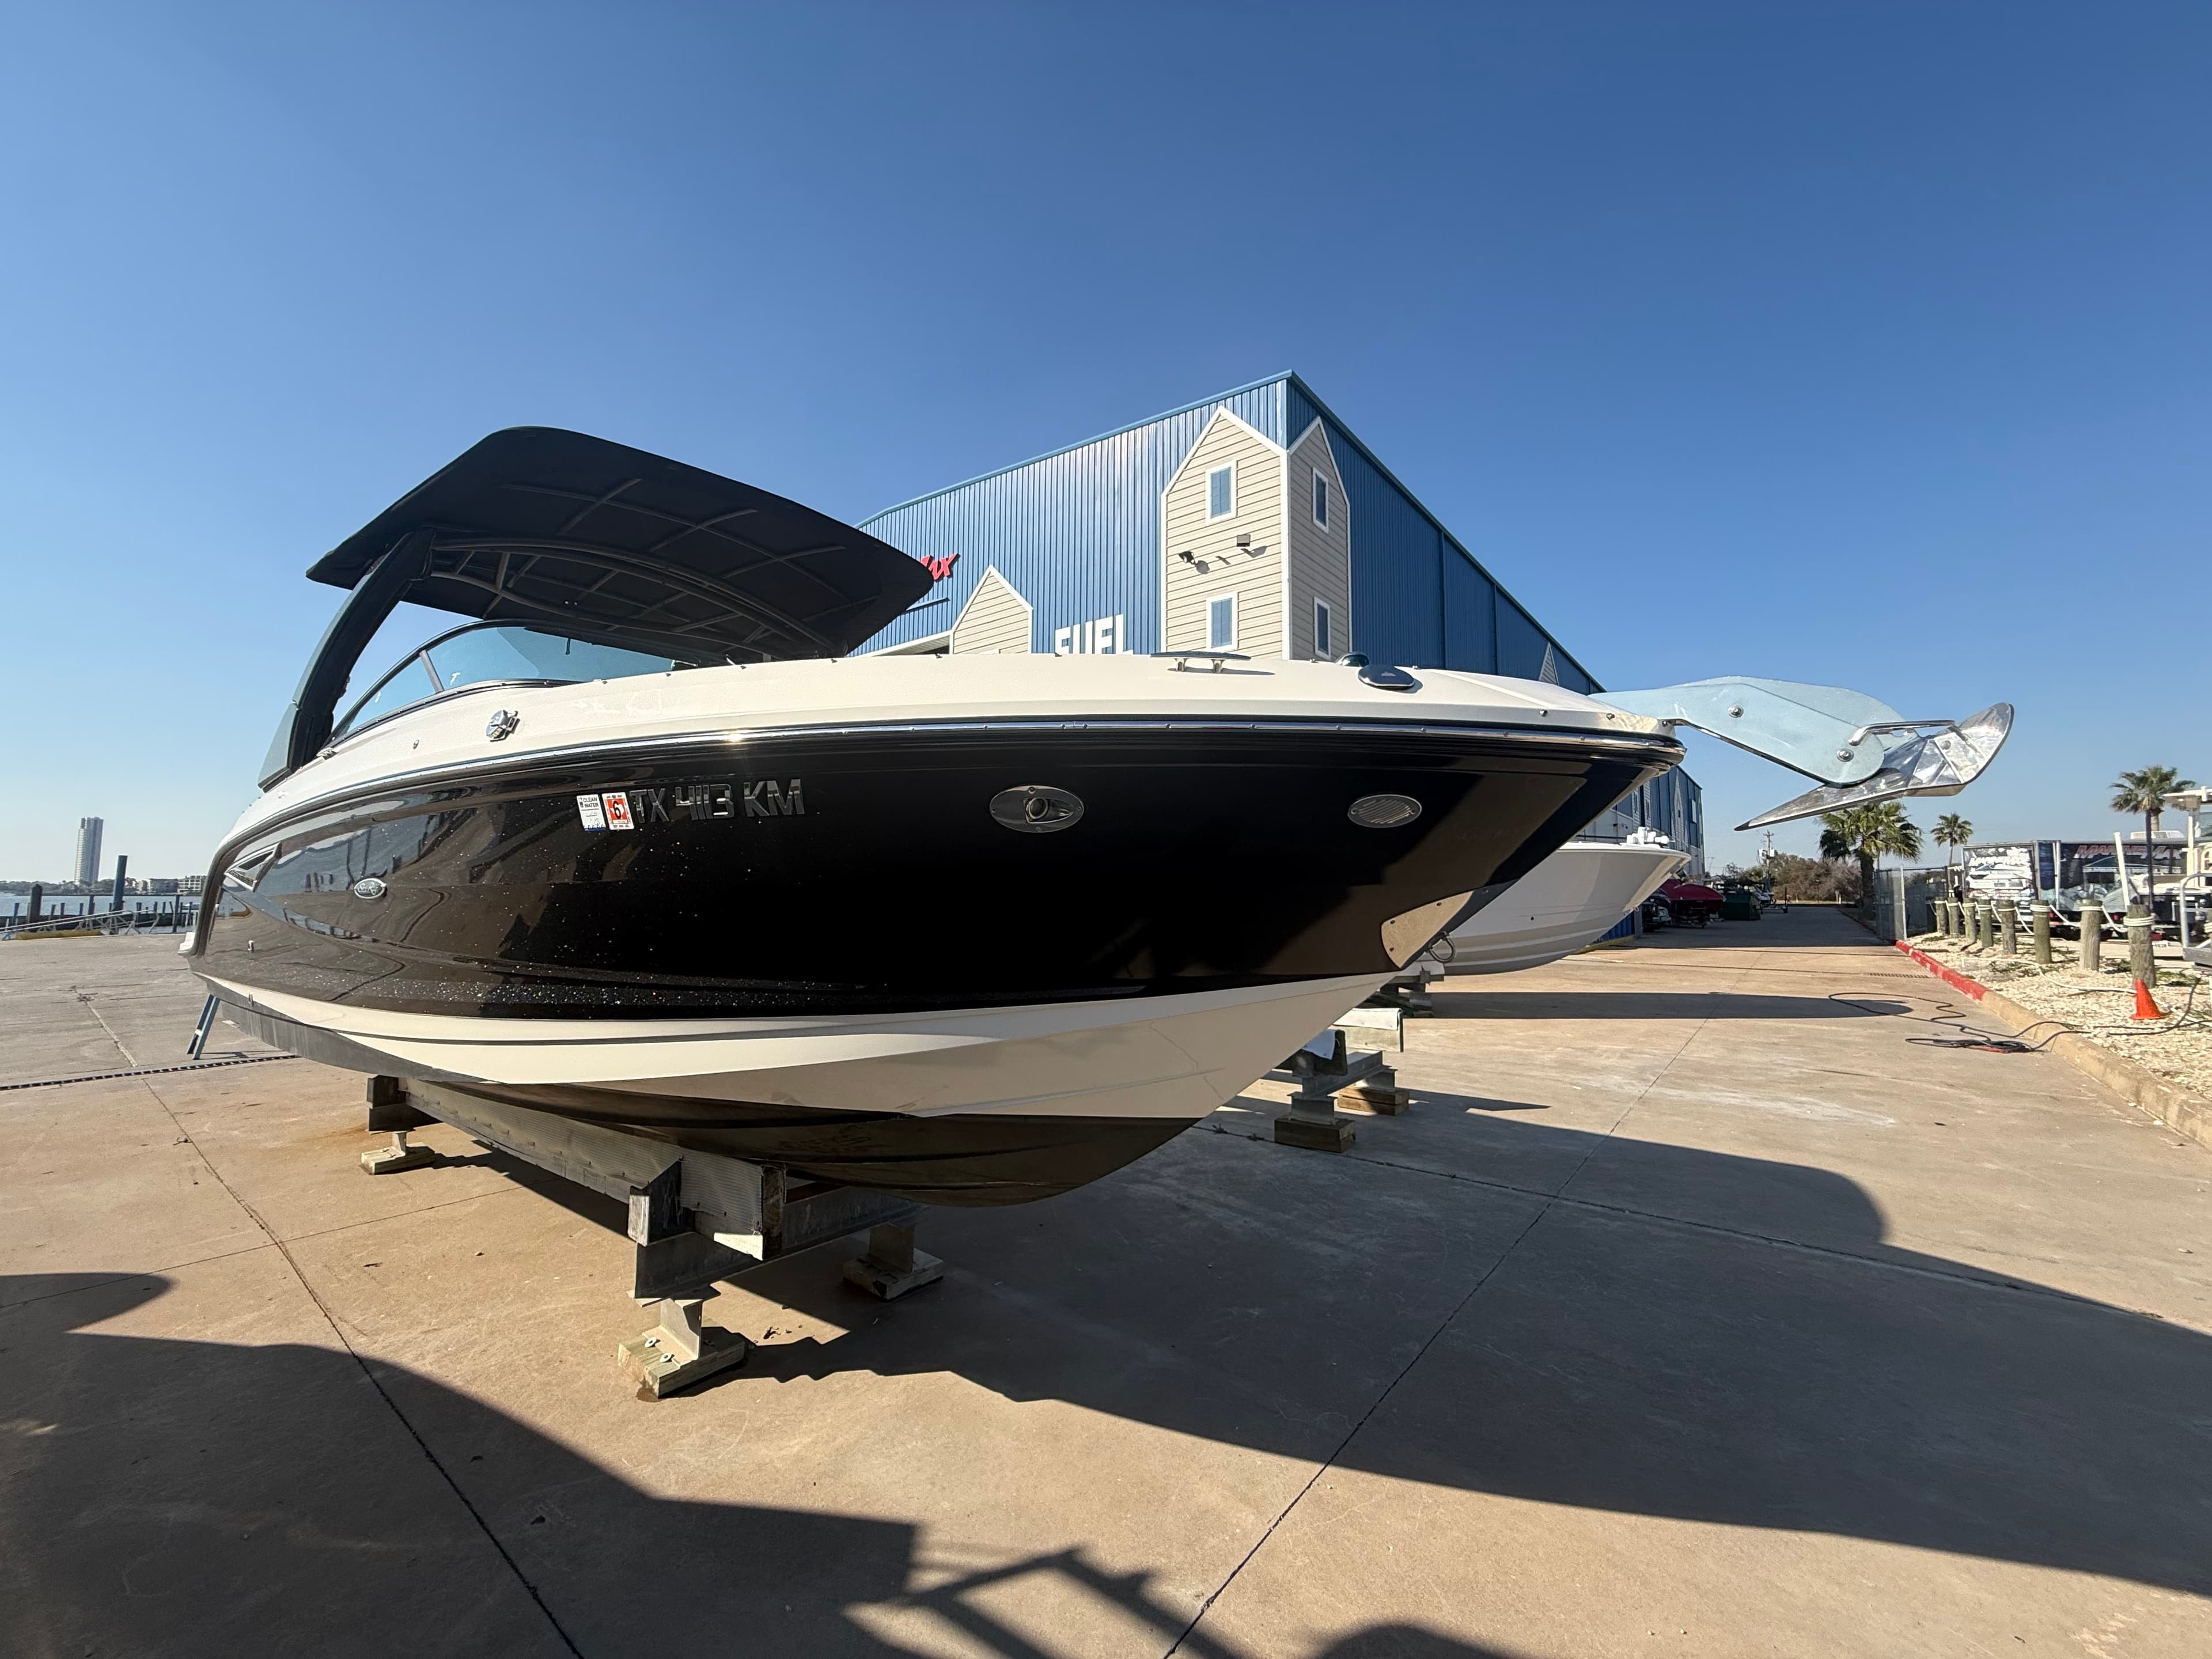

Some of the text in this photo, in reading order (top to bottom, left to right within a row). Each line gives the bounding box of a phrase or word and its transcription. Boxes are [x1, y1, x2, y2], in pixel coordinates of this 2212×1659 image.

[1055, 613, 1133, 654] FUEL
[613, 800, 622, 819] 6
[630, 787, 669, 823] TX
[744, 779, 805, 817] KM
